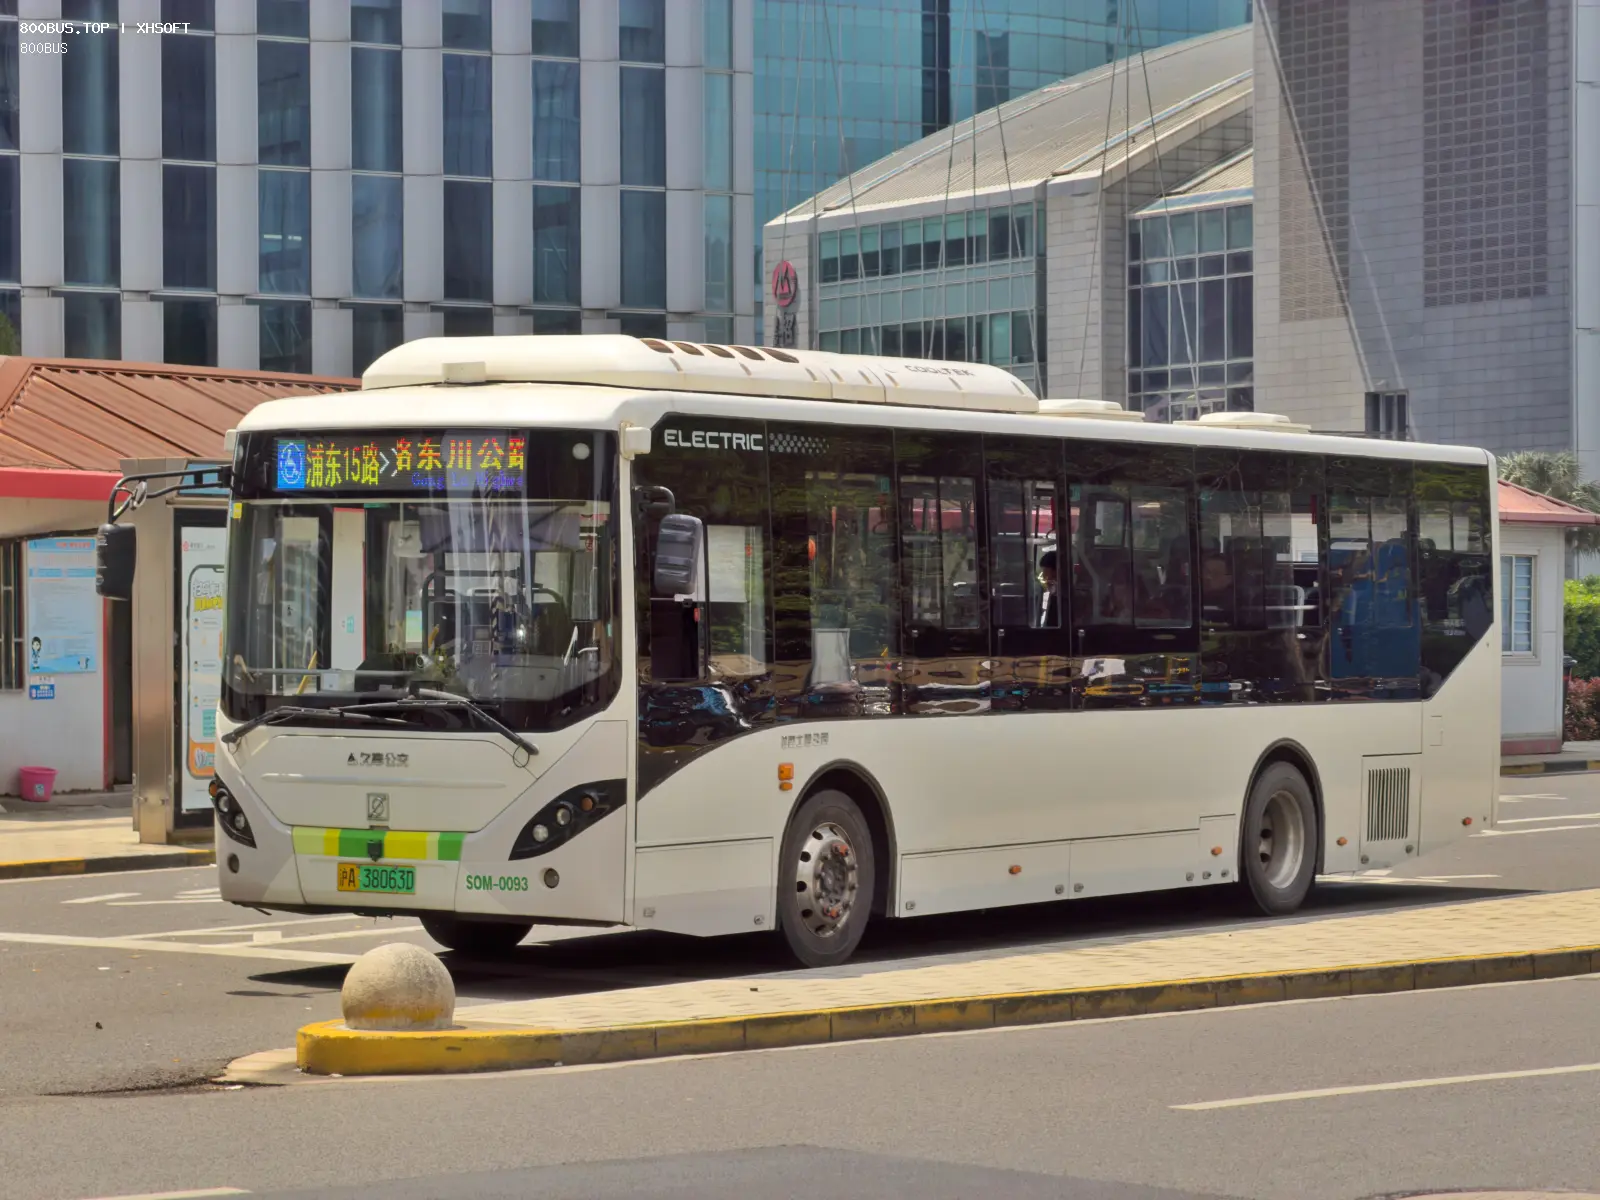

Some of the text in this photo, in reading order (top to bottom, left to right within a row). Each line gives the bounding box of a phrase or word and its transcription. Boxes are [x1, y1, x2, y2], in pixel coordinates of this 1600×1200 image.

[663, 428, 764, 451] ELECTRIC
[306, 441, 379, 487] 浦东15路
